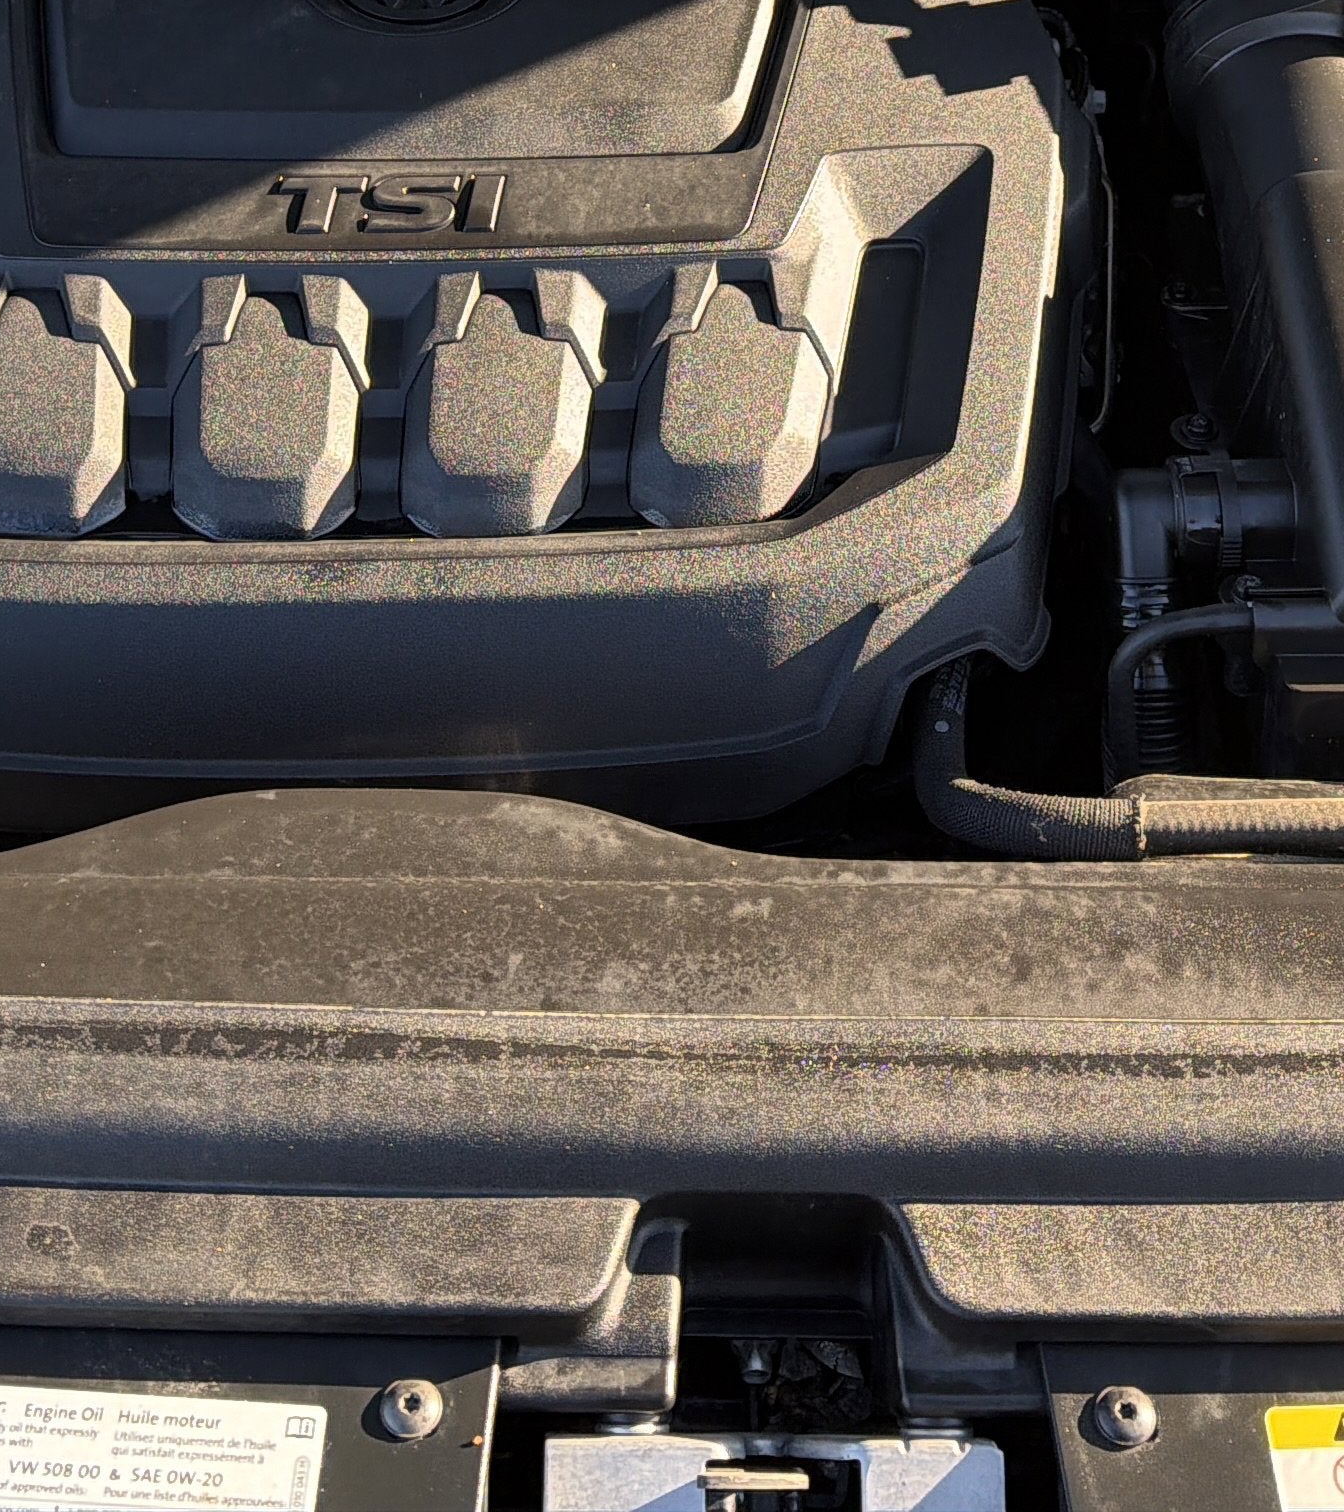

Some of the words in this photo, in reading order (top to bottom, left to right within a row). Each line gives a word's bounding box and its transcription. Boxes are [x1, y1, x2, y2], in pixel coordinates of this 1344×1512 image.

[267, 172, 509, 236] TSI
[24, 1403, 77, 1422] Engine
[81, 1407, 104, 1422] Oil
[118, 1409, 160, 1426] Huile
[163, 1412, 222, 1429] moteur
[9, 1423, 22, 1433] oil
[25, 1424, 47, 1434] that
[49, 1426, 99, 1440] expressly
[114, 1430, 154, 1442] Utilisez
[157, 1433, 224, 1448] uniquement
[227, 1438, 242, 1449] de
[9, 1437, 33, 1448] with
[111, 1445, 129, 1457] qui
[132, 1446, 175, 1458] satisfait
[177, 1449, 255, 1464] expressément
[8, 1459, 40, 1475] VW
[42, 1462, 73, 1478] 508
[78, 1464, 101, 1480] 00
[109, 1468, 121, 1481] &
[131, 1467, 162, 1484] SAE
[166, 1470, 224, 1487] 0W-20
[10, 1482, 63, 1494] approved
[104, 1487, 128, 1499] Pour
[131, 1490, 152, 1500] une
[155, 1490, 177, 1501] liste
[178, 1491, 219, 1504] d'huiles
